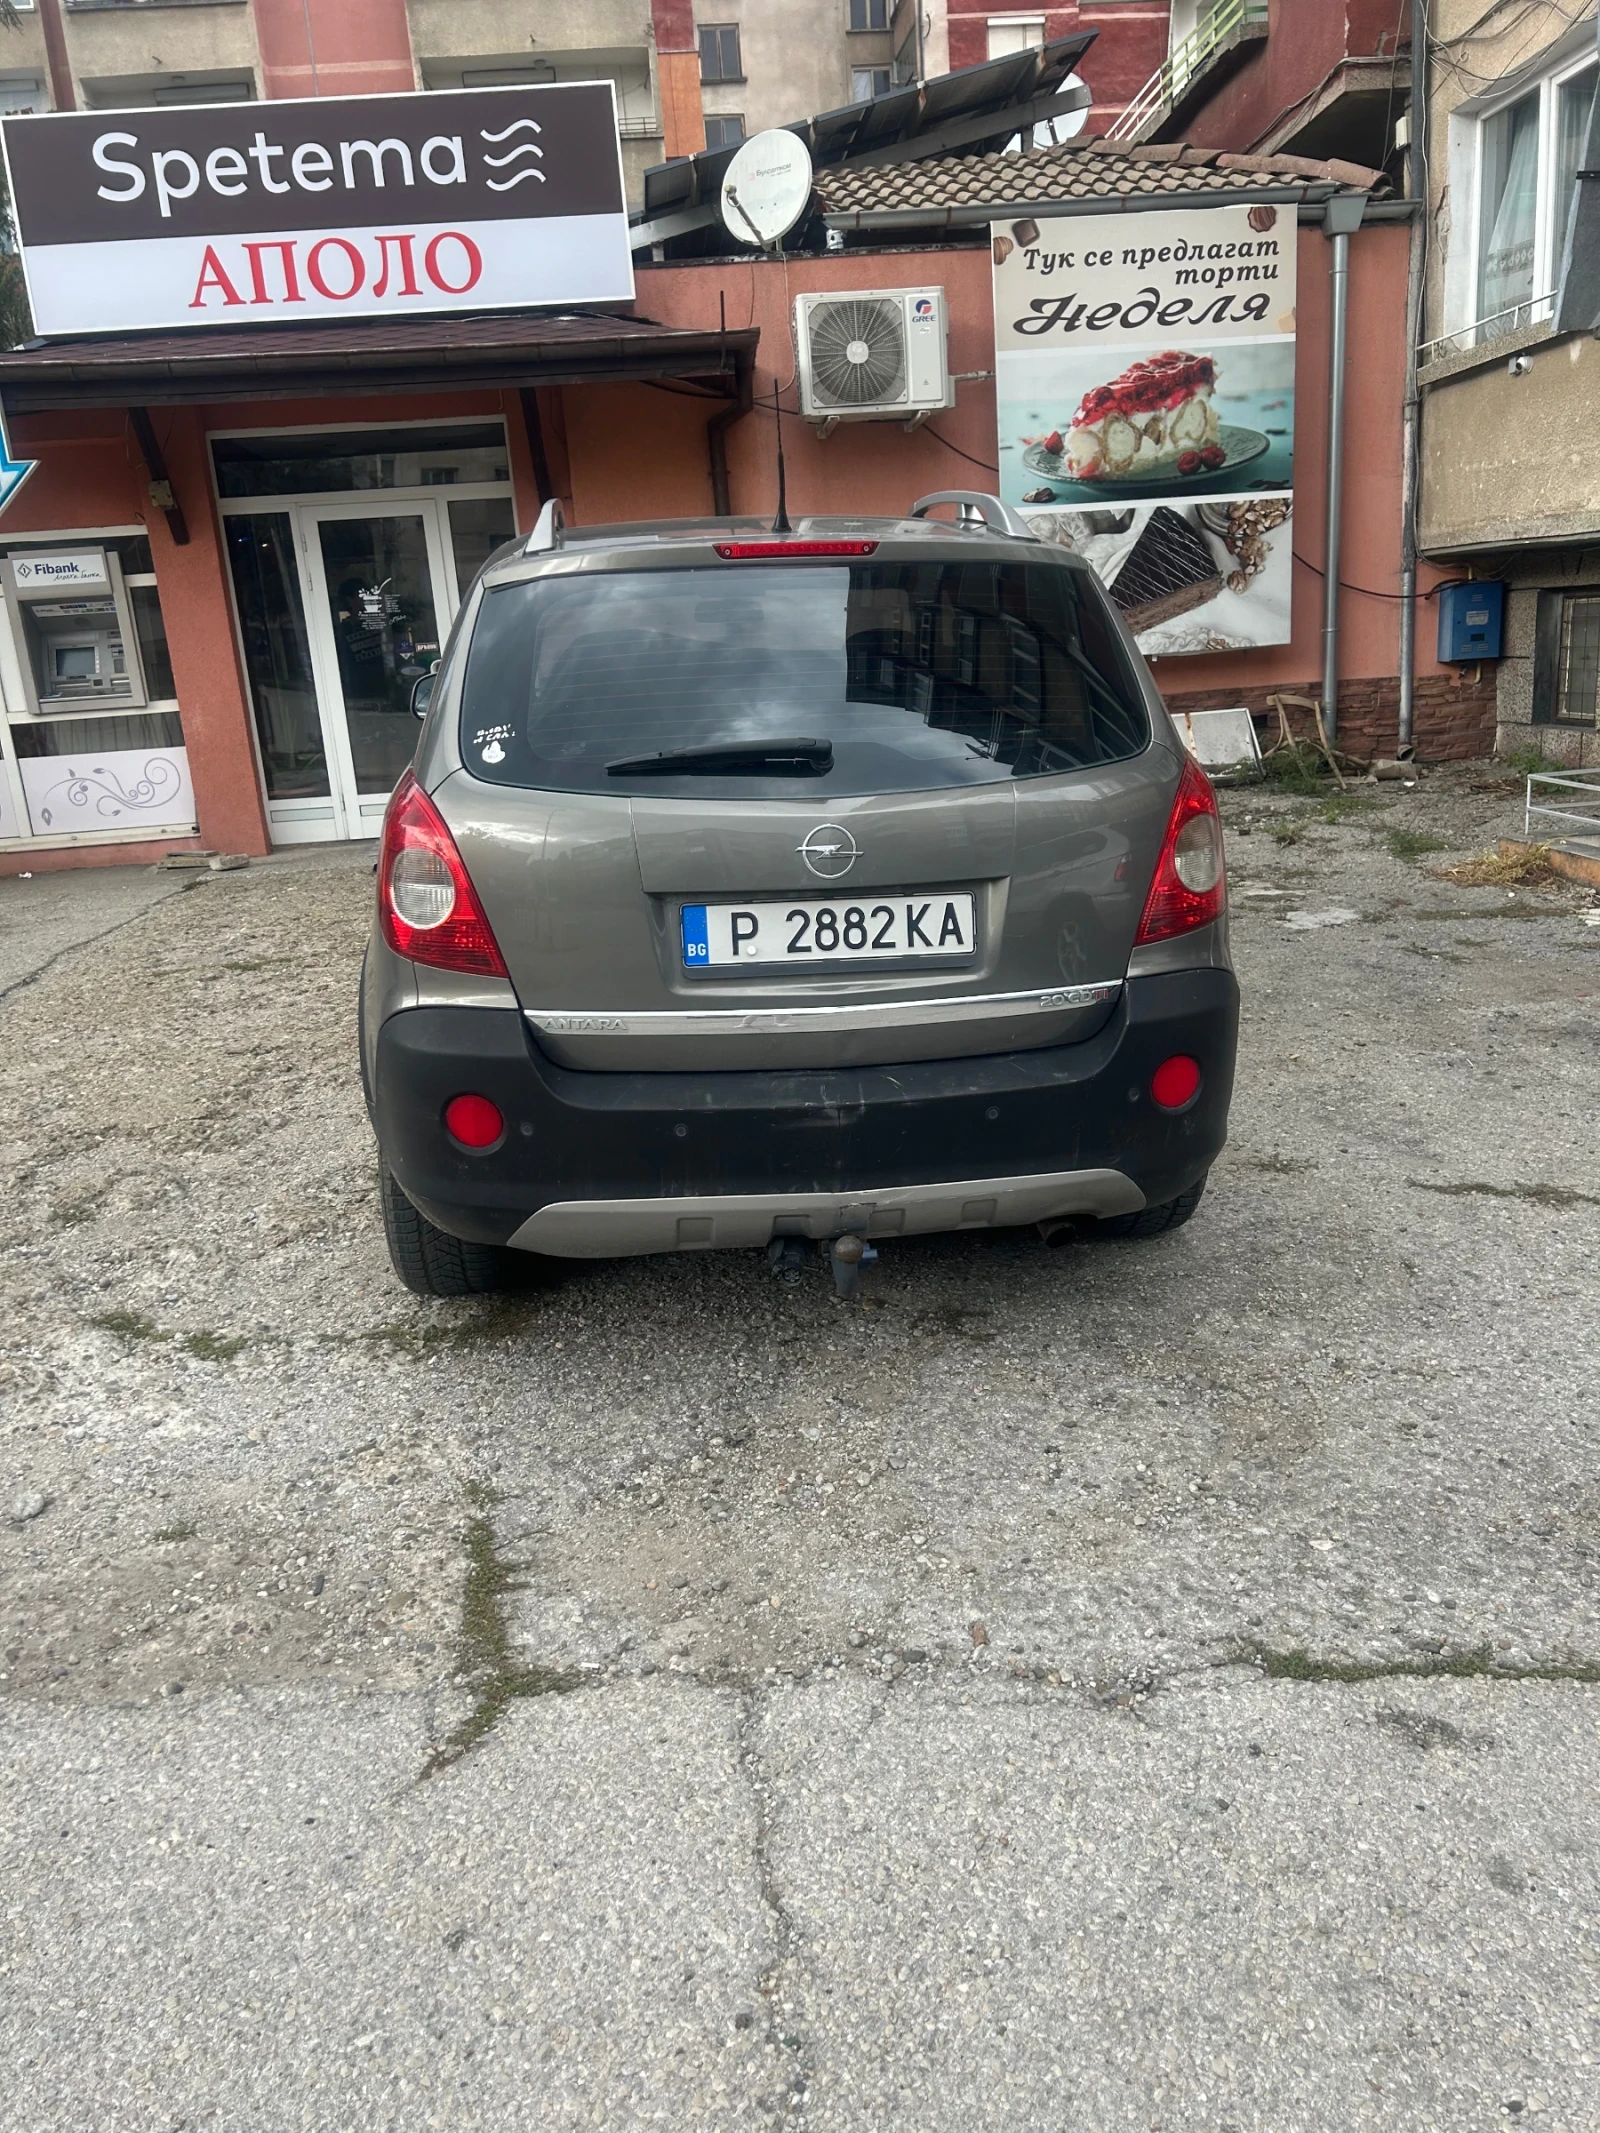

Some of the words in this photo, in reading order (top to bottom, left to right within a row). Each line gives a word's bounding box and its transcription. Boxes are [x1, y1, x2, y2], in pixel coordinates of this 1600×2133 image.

[91, 131, 468, 217] Spetema
[188, 231, 483, 308] АПОЛО
[1023, 249, 1075, 275] Тук
[1083, 250, 1113, 267] се
[1122, 238, 1280, 270] предлагат
[1174, 261, 1280, 289] торти
[912, 315, 936, 323] GREE
[1012, 286, 1272, 336] Неделя
[34, 562, 79, 575] Fibank
[687, 943, 707, 957] BG
[730, 911, 759, 957] P
[544, 1018, 629, 1031] ANTARA
